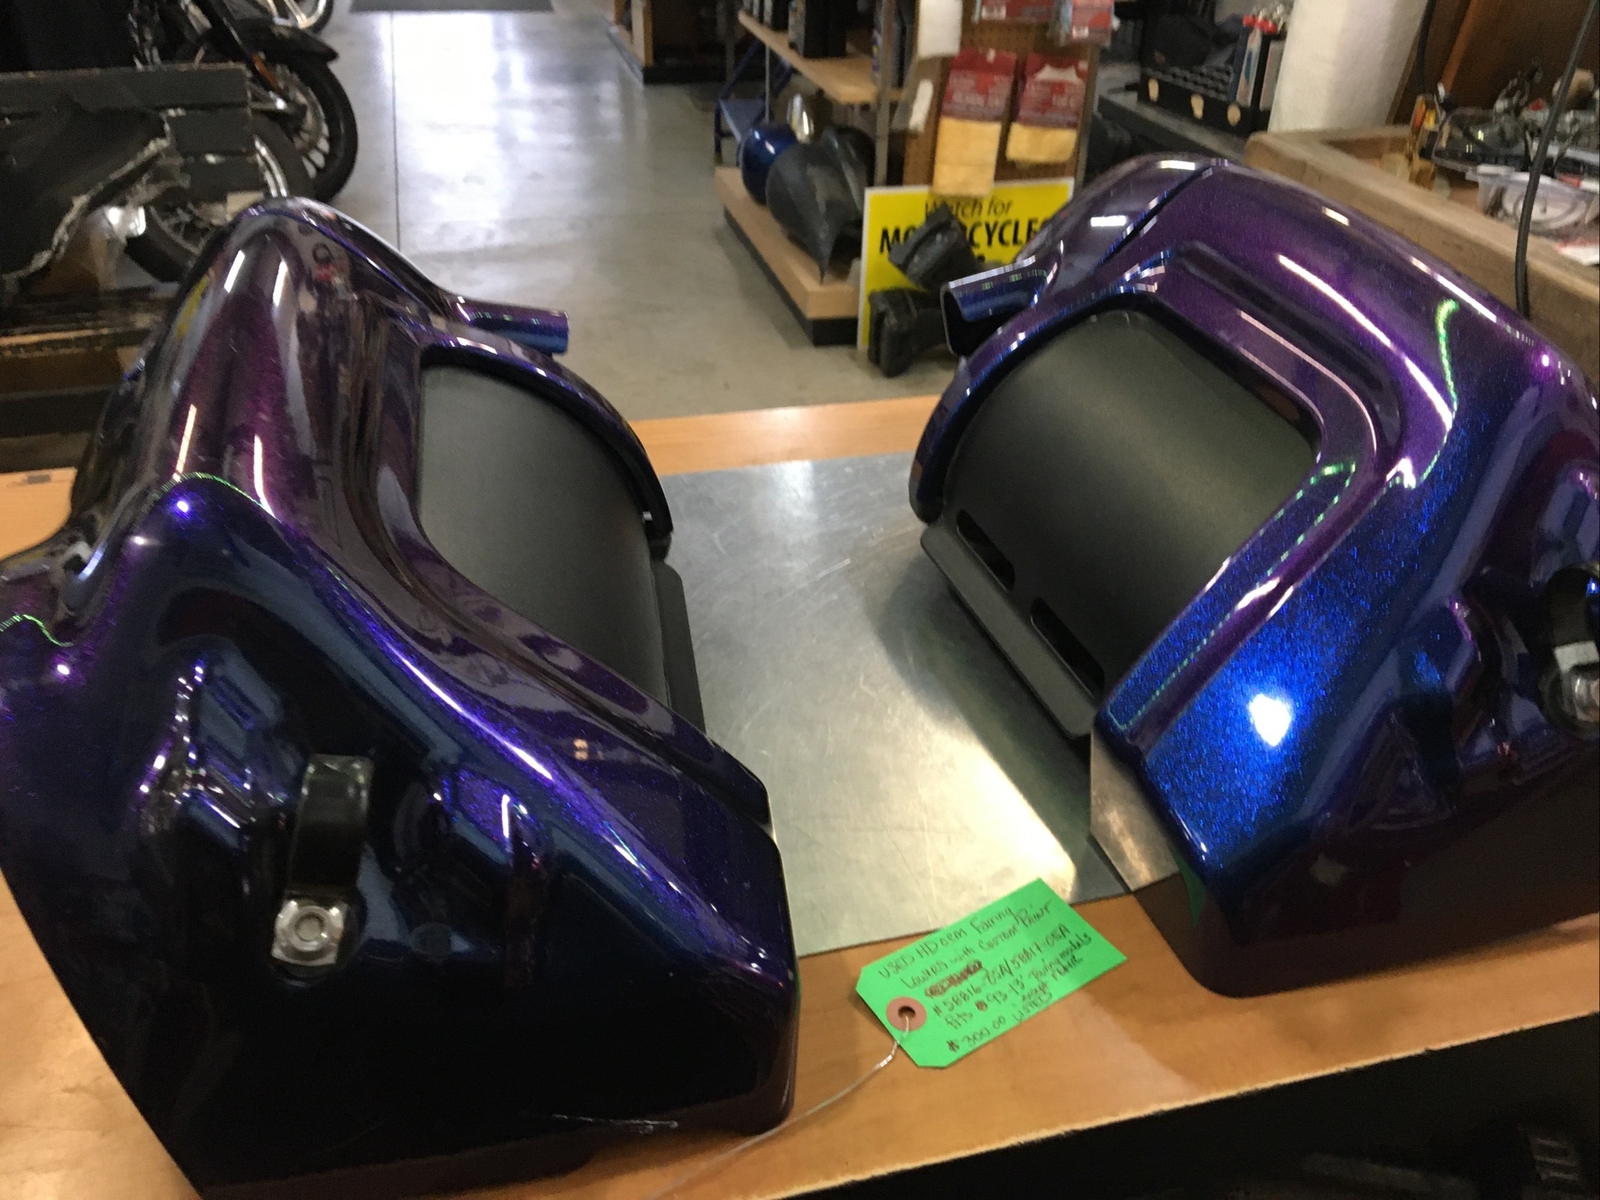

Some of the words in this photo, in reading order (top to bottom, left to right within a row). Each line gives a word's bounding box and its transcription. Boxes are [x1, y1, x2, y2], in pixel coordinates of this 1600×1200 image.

[987, 197, 1014, 217] for
[878, 953, 916, 978] USED
[916, 939, 939, 960] HD
[970, 907, 1021, 935] Fairing
